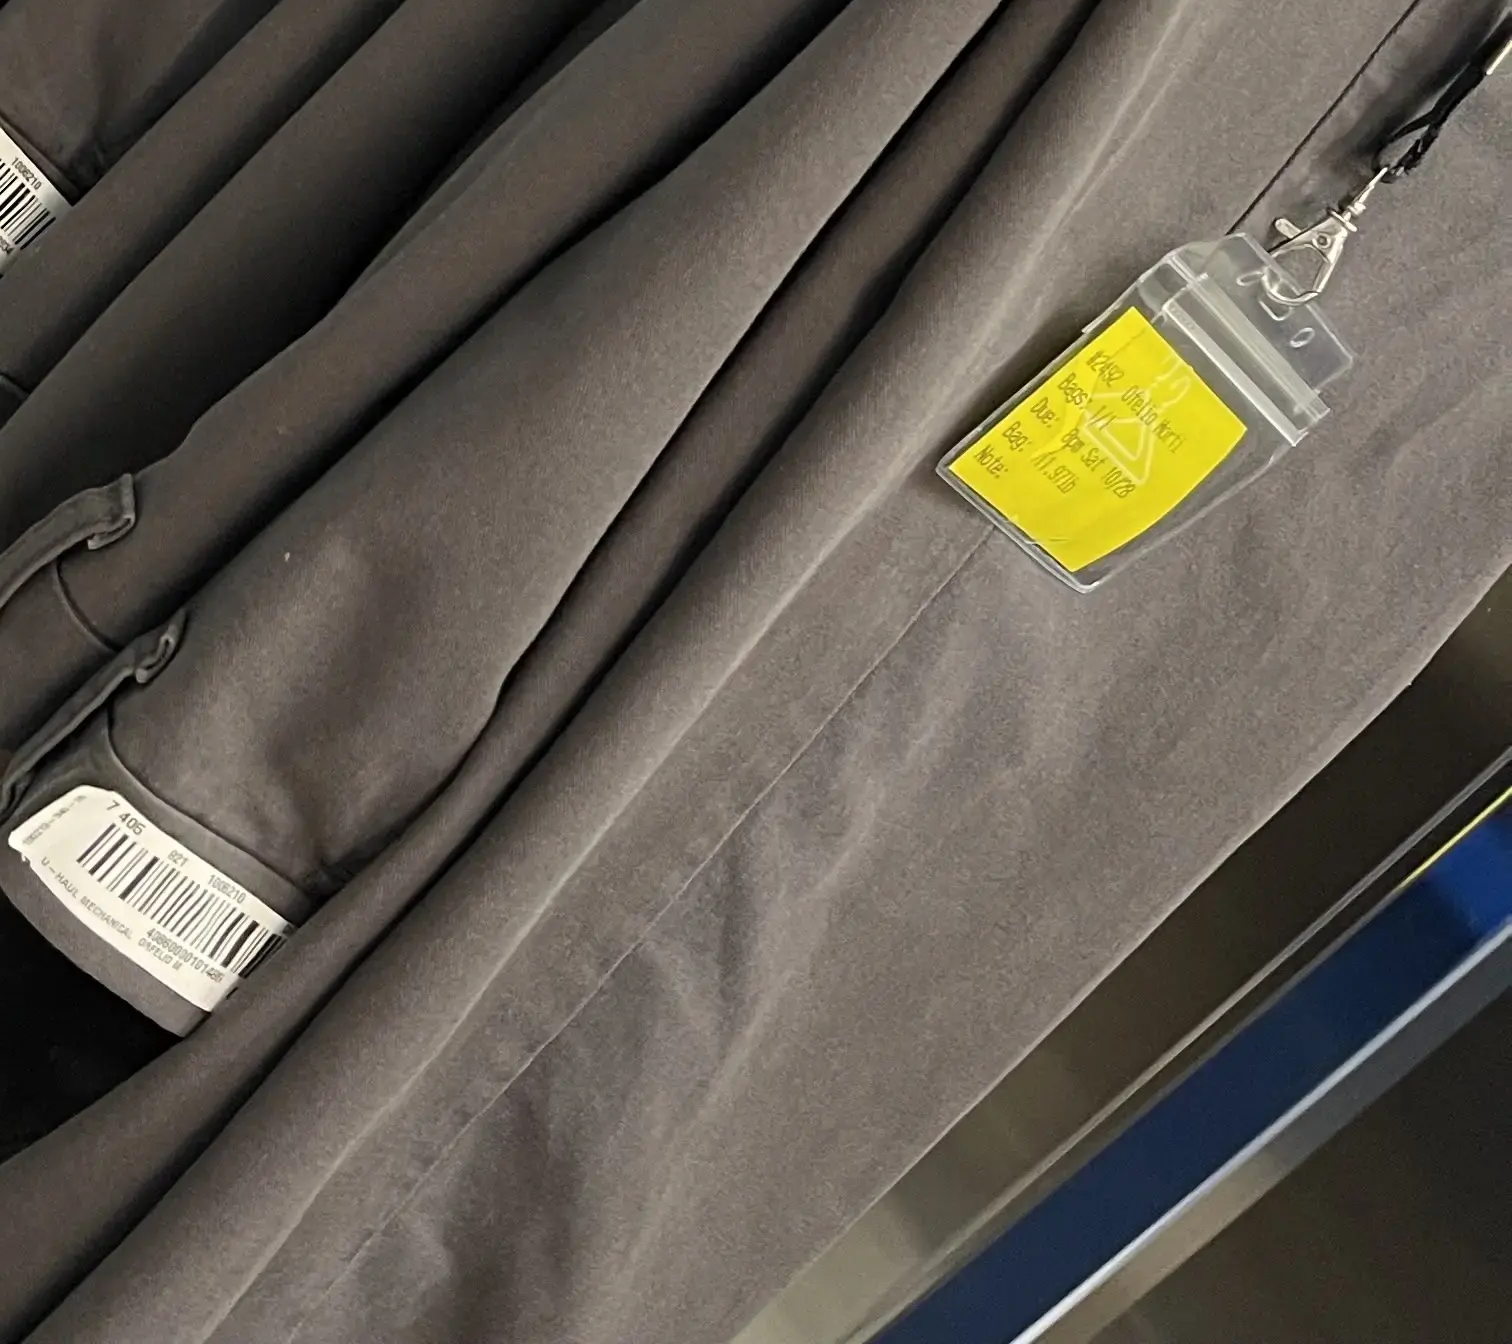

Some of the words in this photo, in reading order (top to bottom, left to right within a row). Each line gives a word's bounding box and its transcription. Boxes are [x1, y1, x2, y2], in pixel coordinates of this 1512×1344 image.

[1057, 371, 1093, 410] Bags:
[1002, 420, 1033, 453] Bag:
[1030, 397, 1060, 429] Due:
[1080, 447, 1108, 472] Sat
[973, 444, 1009, 479] Note:
[105, 800, 120, 812] 7
[79, 894, 134, 941] MECHANICAL
